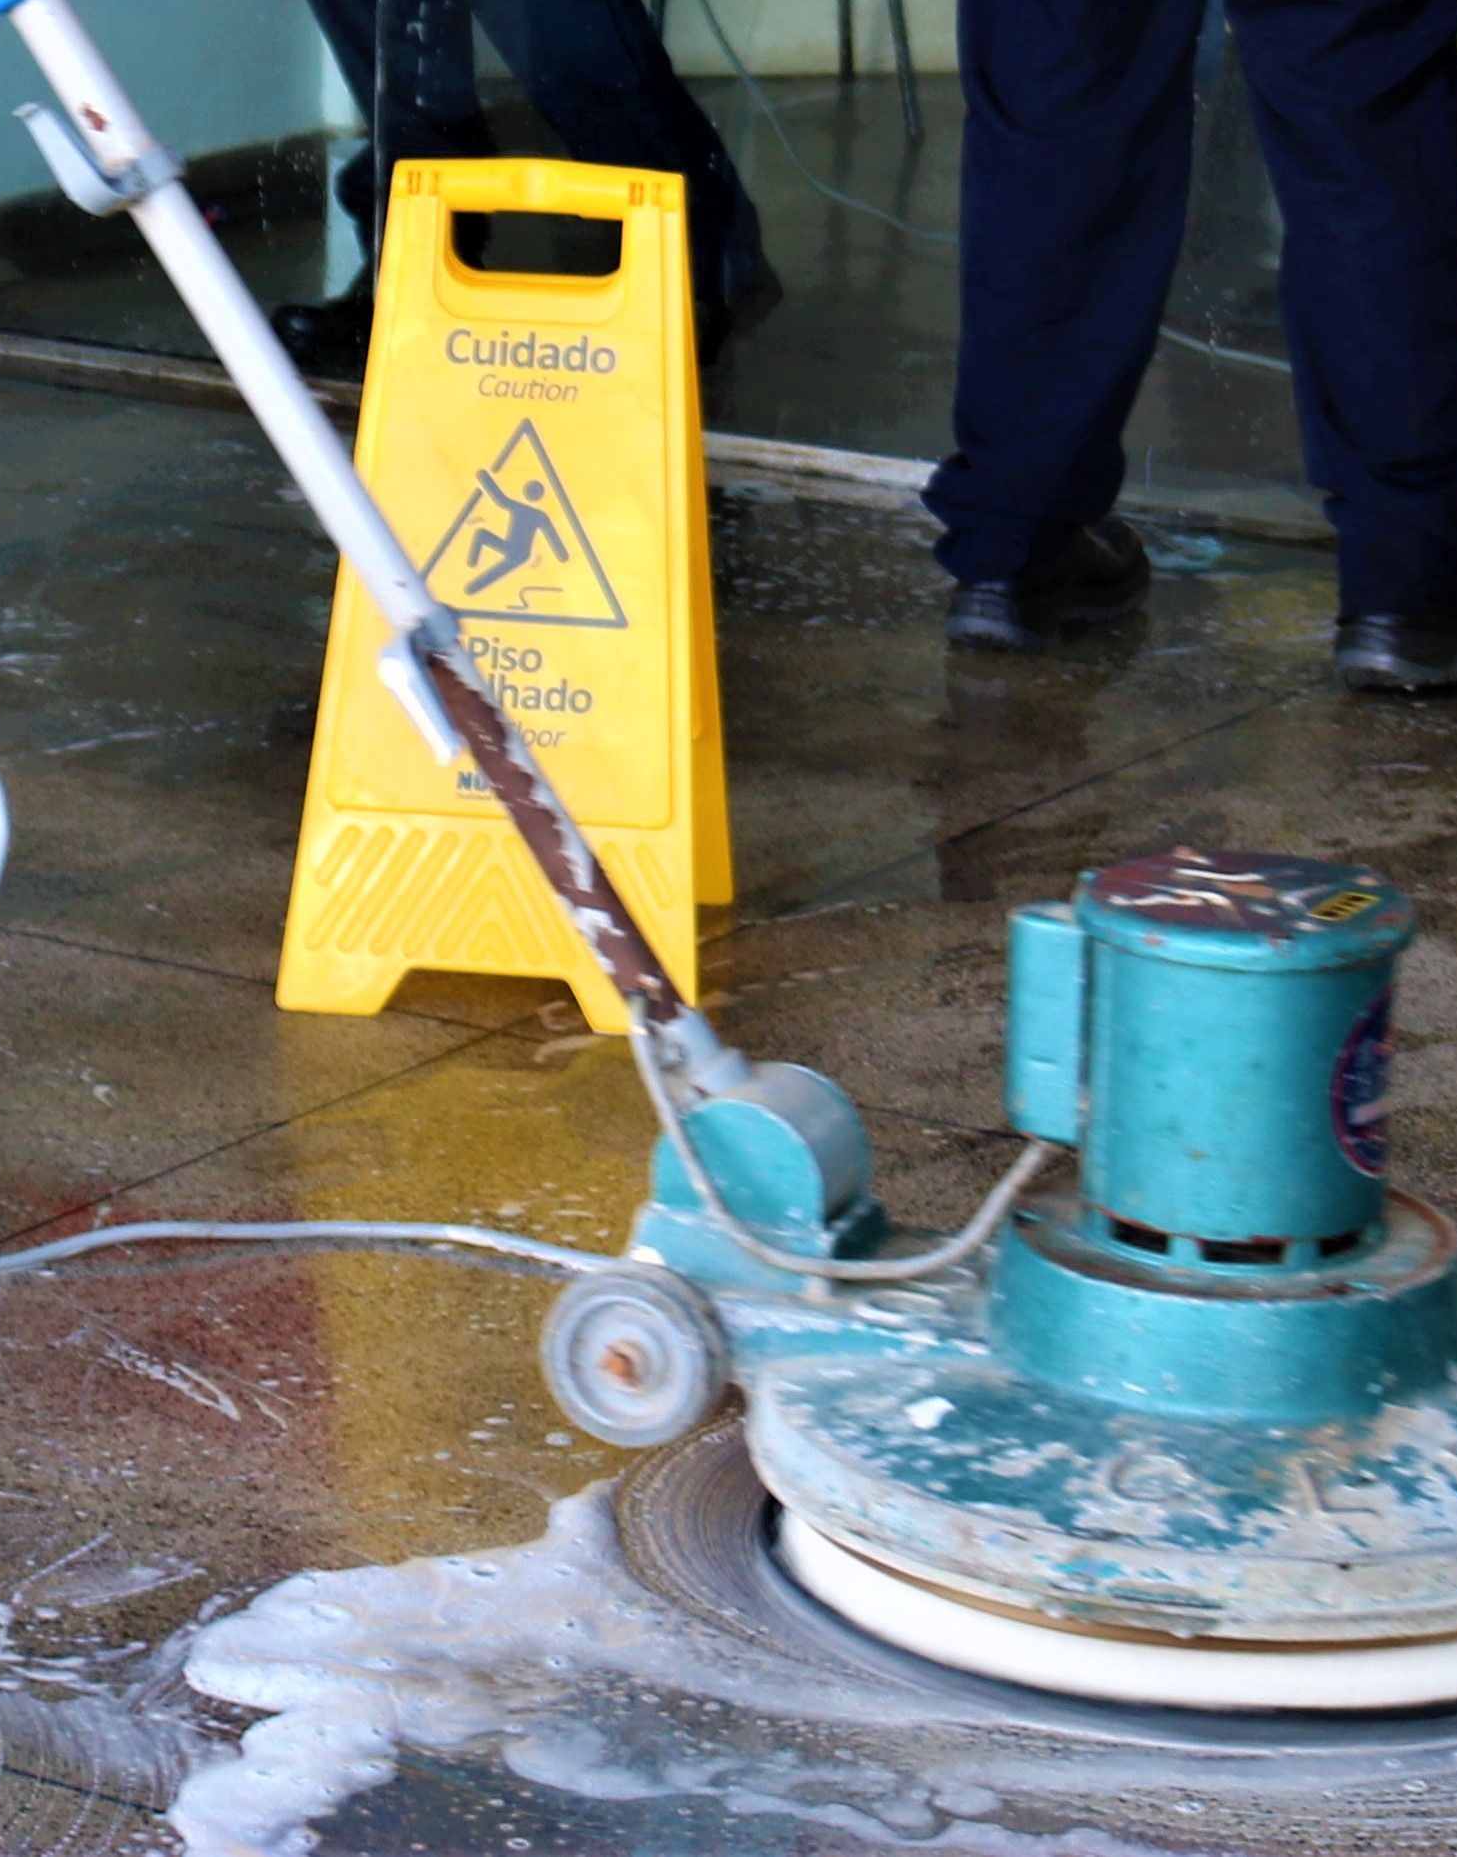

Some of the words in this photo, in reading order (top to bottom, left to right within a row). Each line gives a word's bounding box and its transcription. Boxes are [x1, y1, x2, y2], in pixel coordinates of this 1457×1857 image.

[445, 327, 617, 375] Cuidado
[477, 373, 579, 403] Caution
[466, 635, 543, 674] Piso
[488, 673, 593, 714] lhado
[514, 720, 567, 749] loor
